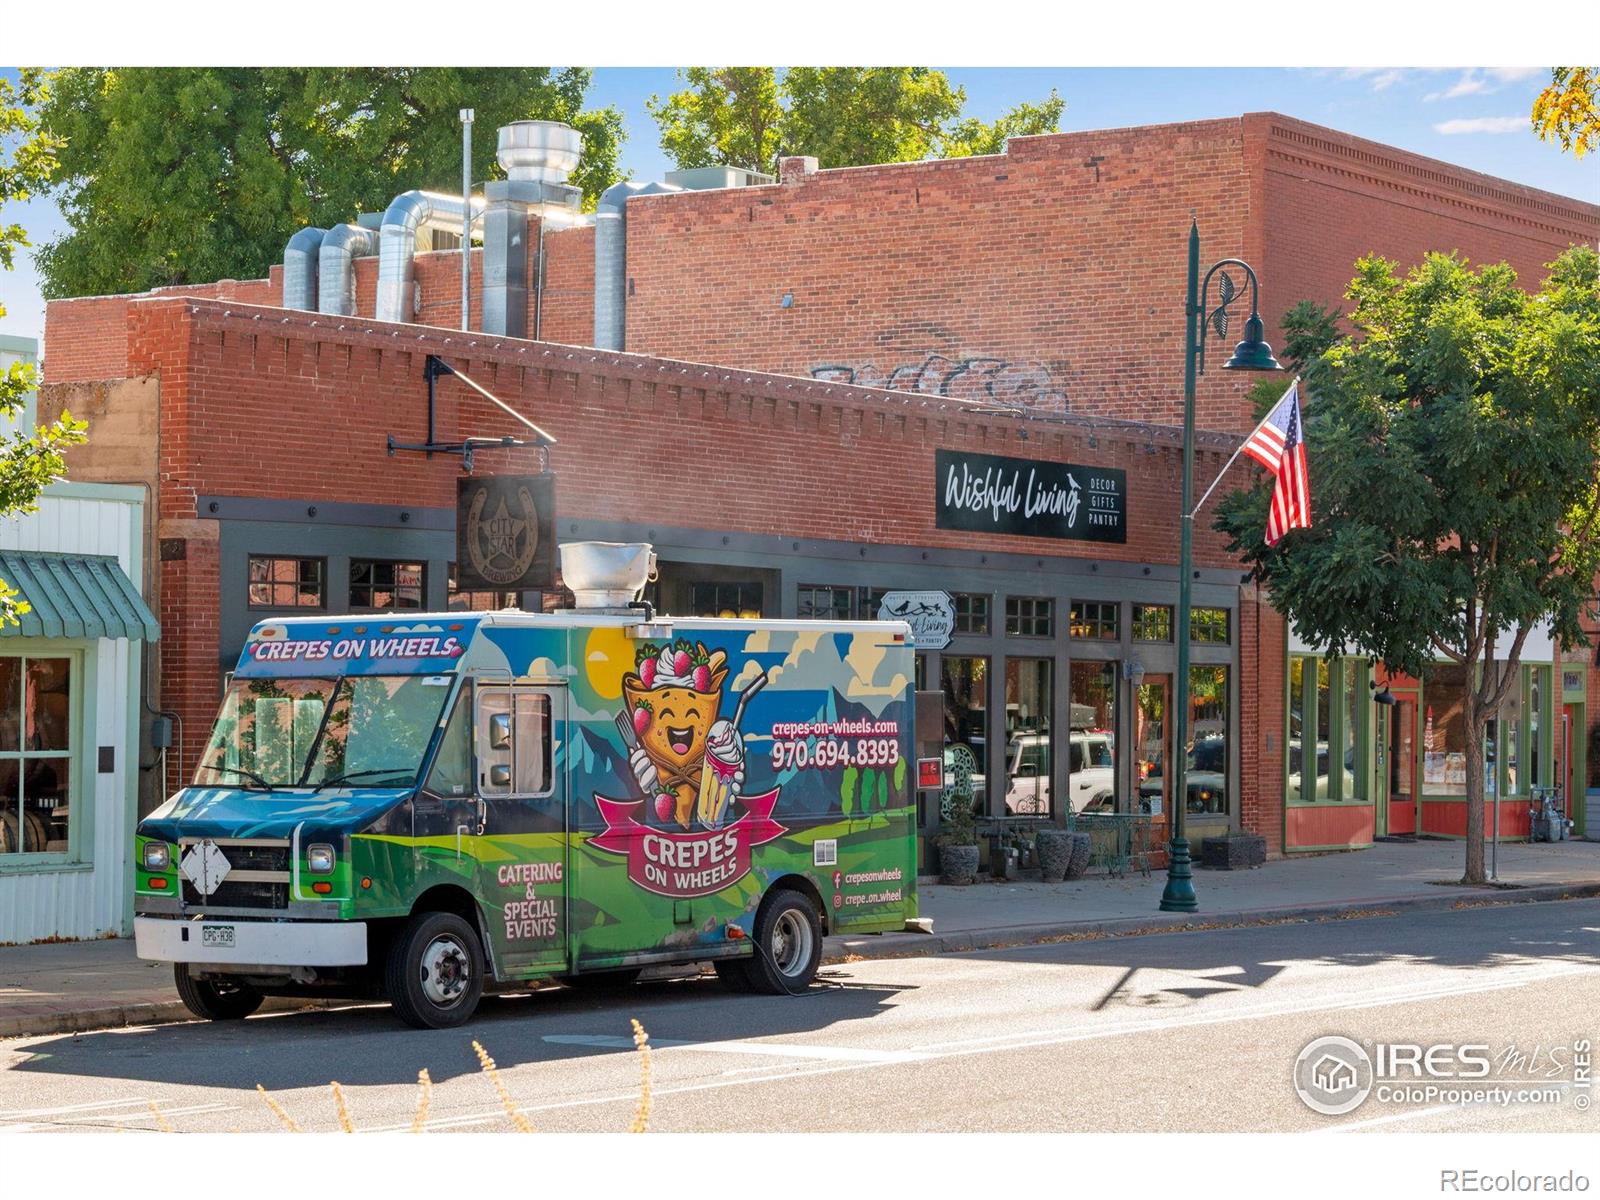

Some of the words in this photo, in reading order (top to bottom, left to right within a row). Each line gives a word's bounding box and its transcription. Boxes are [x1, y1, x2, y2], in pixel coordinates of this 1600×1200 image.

[1090, 478, 1116, 491] DECOR
[945, 462, 1021, 522] Wishful
[1025, 468, 1081, 529] Living
[1091, 495, 1115, 509] GIFTS
[490, 518, 515, 534] CITY
[1088, 513, 1118, 527] PANTRY
[489, 536, 515, 555] STAR
[482, 565, 523, 581] BREWING
[921, 617, 948, 635] Living
[255, 640, 332, 660] CREPES
[333, 639, 365, 658] ON
[369, 637, 458, 658] WHEELS
[772, 717, 898, 739] crepes-on-wheels.com
[772, 739, 899, 768] 970.694.8393
[643, 828, 740, 868] CREPES
[498, 862, 563, 884] CATERING
[644, 863, 667, 887] ON
[673, 856, 737, 889] WHEELS
[845, 867, 902, 886] crepesonwheels
[525, 881, 536, 900] &
[503, 899, 558, 921] SPECIAL
[505, 918, 557, 940] EVENTS
